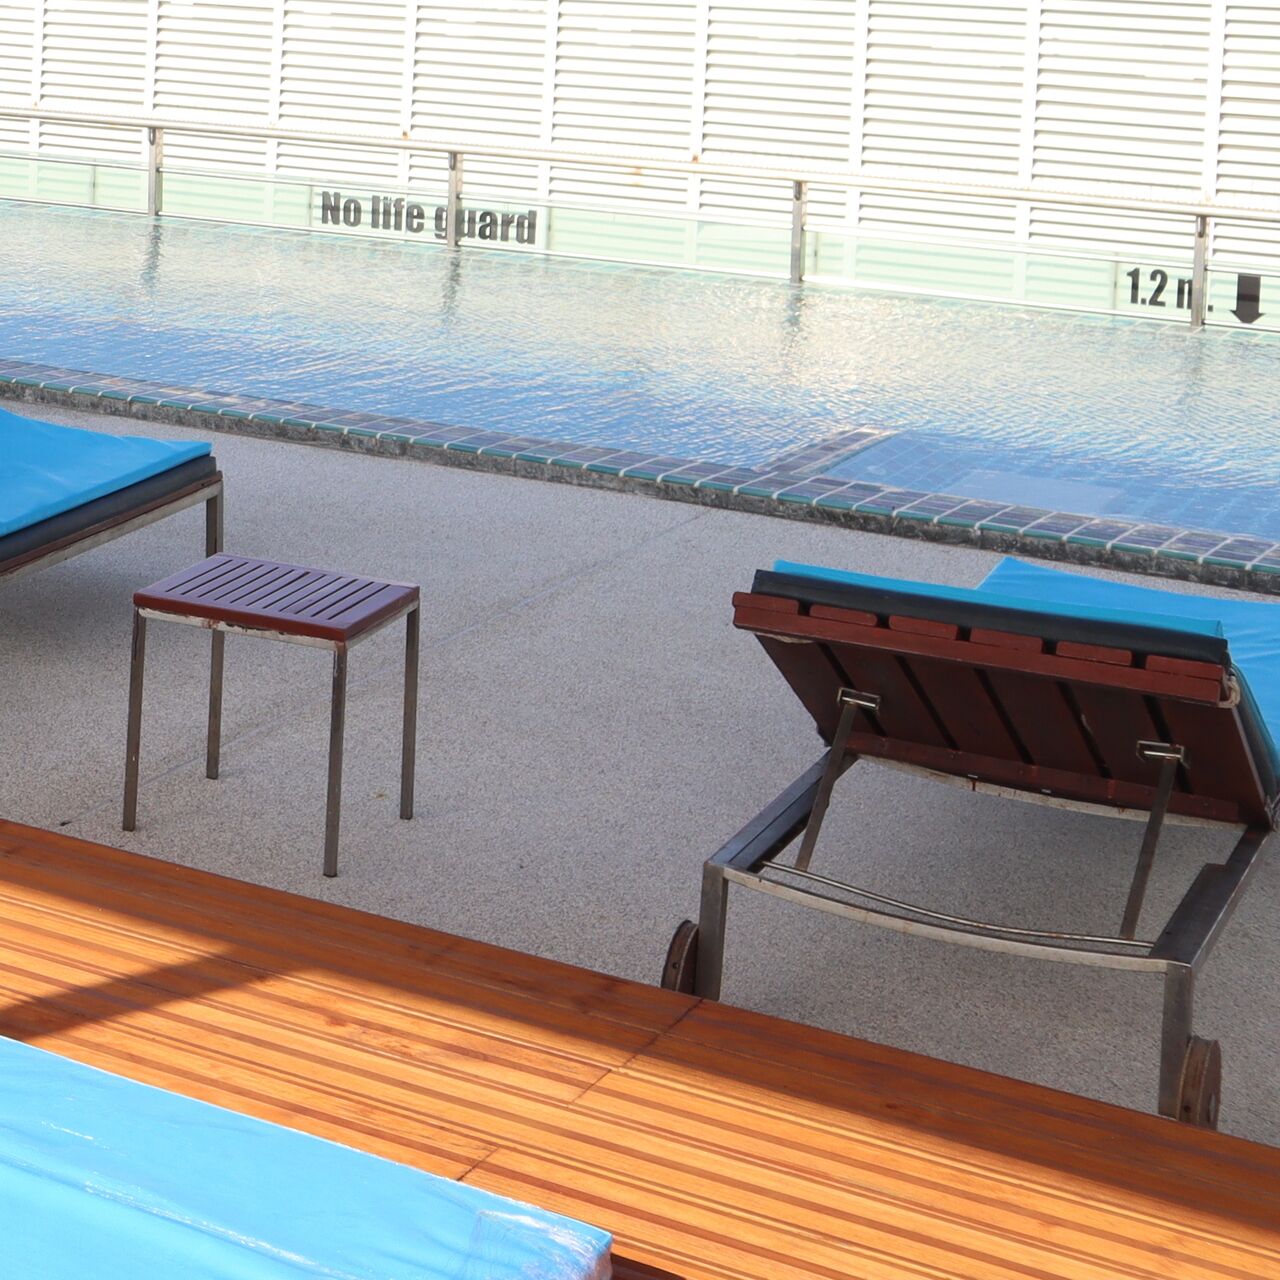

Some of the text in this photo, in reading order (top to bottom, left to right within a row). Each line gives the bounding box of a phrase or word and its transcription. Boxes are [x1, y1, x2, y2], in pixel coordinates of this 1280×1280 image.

[321, 191, 537, 245] No life guard
[1126, 267, 1168, 307] 1.2
